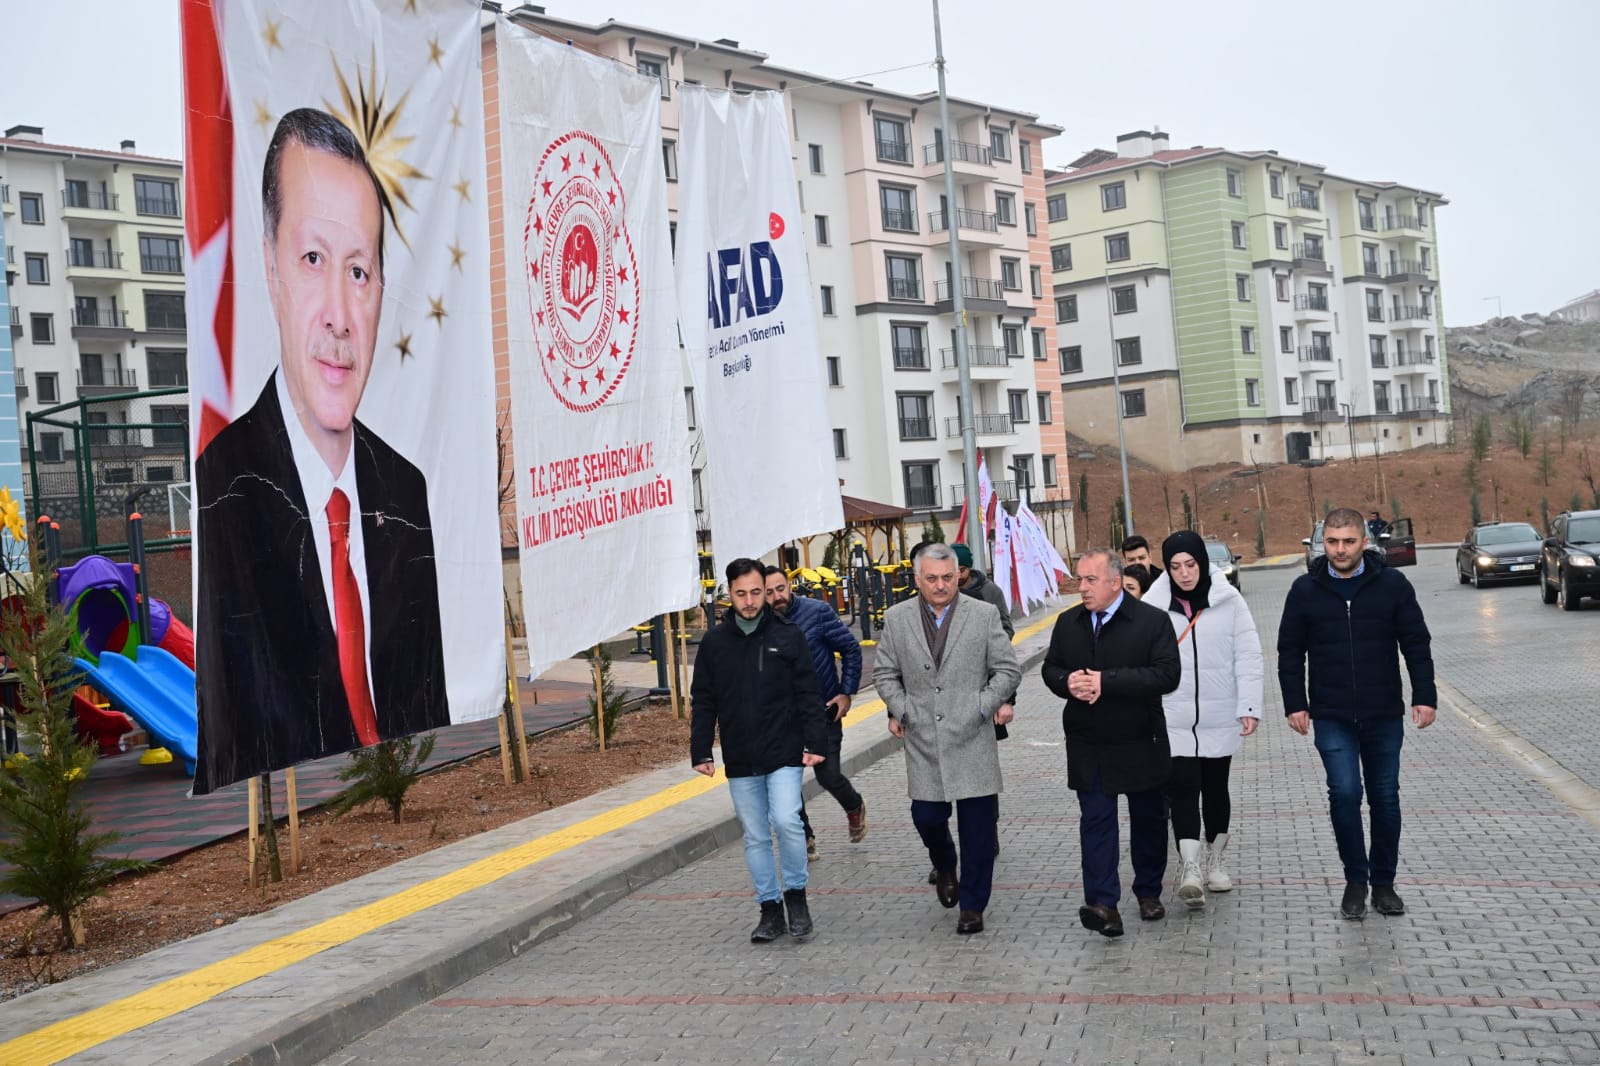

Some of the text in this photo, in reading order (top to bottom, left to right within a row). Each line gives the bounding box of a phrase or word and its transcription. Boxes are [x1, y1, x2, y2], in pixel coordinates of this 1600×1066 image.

[547, 198, 565, 236] ÇEVRE
[708, 241, 783, 328] AFAD
[549, 457, 582, 501] ÇEVRE
[522, 507, 552, 549] İKLİM
[553, 487, 619, 539] DEĞİŞİKLİĞİ
